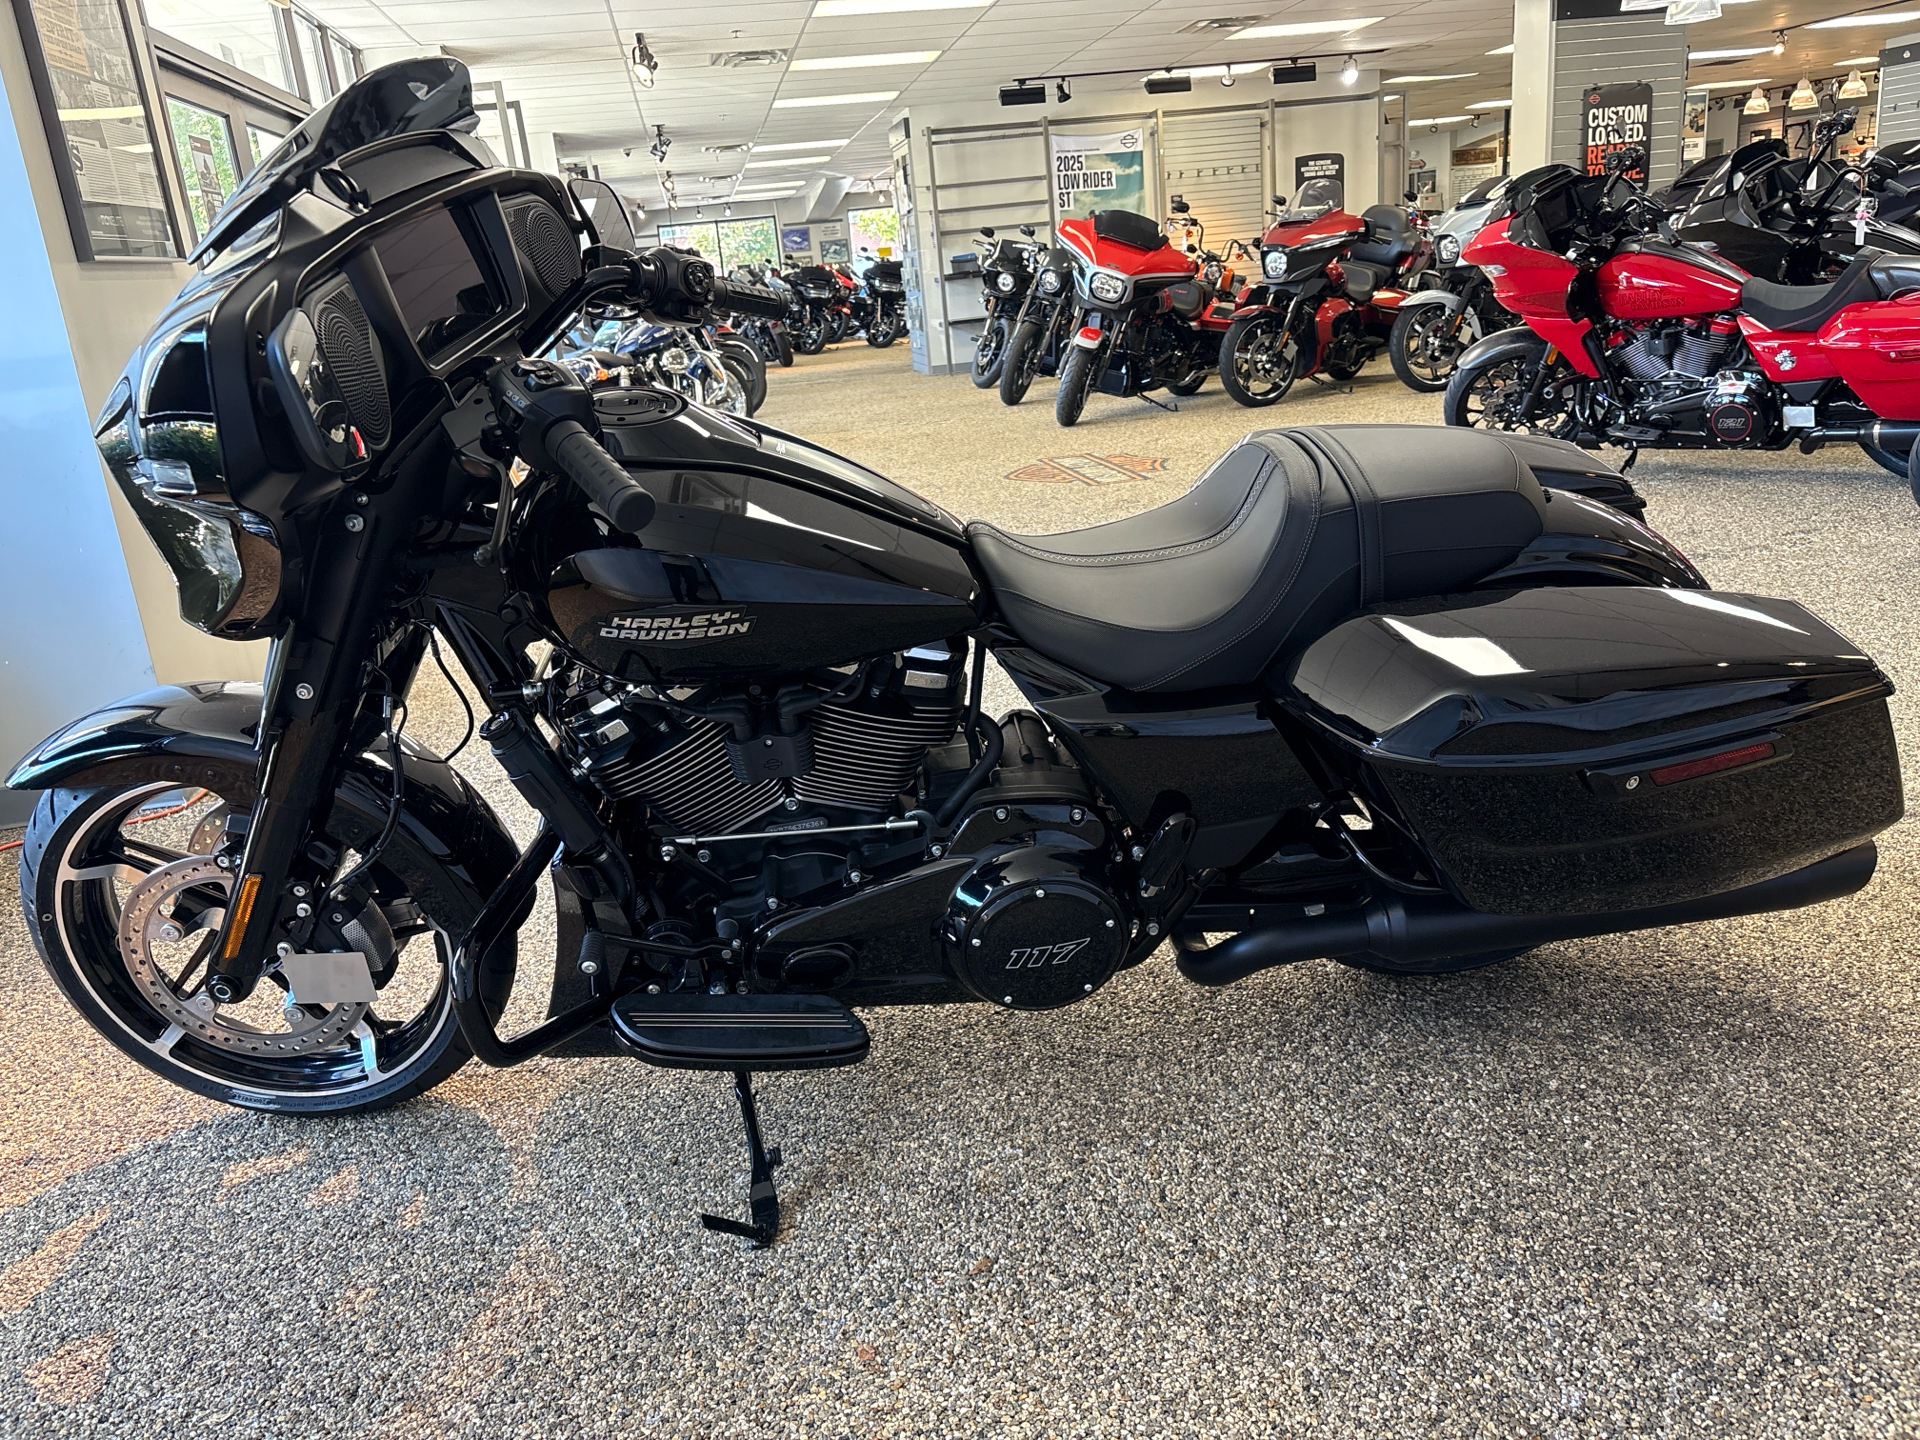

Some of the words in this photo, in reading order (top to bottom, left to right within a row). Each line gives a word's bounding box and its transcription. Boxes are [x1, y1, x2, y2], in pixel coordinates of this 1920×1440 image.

[1588, 104, 1648, 127] CUSTOM
[1056, 155, 1083, 172] 2025
[1057, 172, 1080, 190] LOW
[1082, 171, 1114, 189] RIDER
[1059, 191, 1071, 208] ST
[1630, 296, 1686, 312] DAVIDSON
[1717, 418, 1745, 426] 121
[611, 611, 740, 630] HARLEY-
[599, 622, 751, 641] DAVIDSON
[1005, 937, 1091, 969] 117
